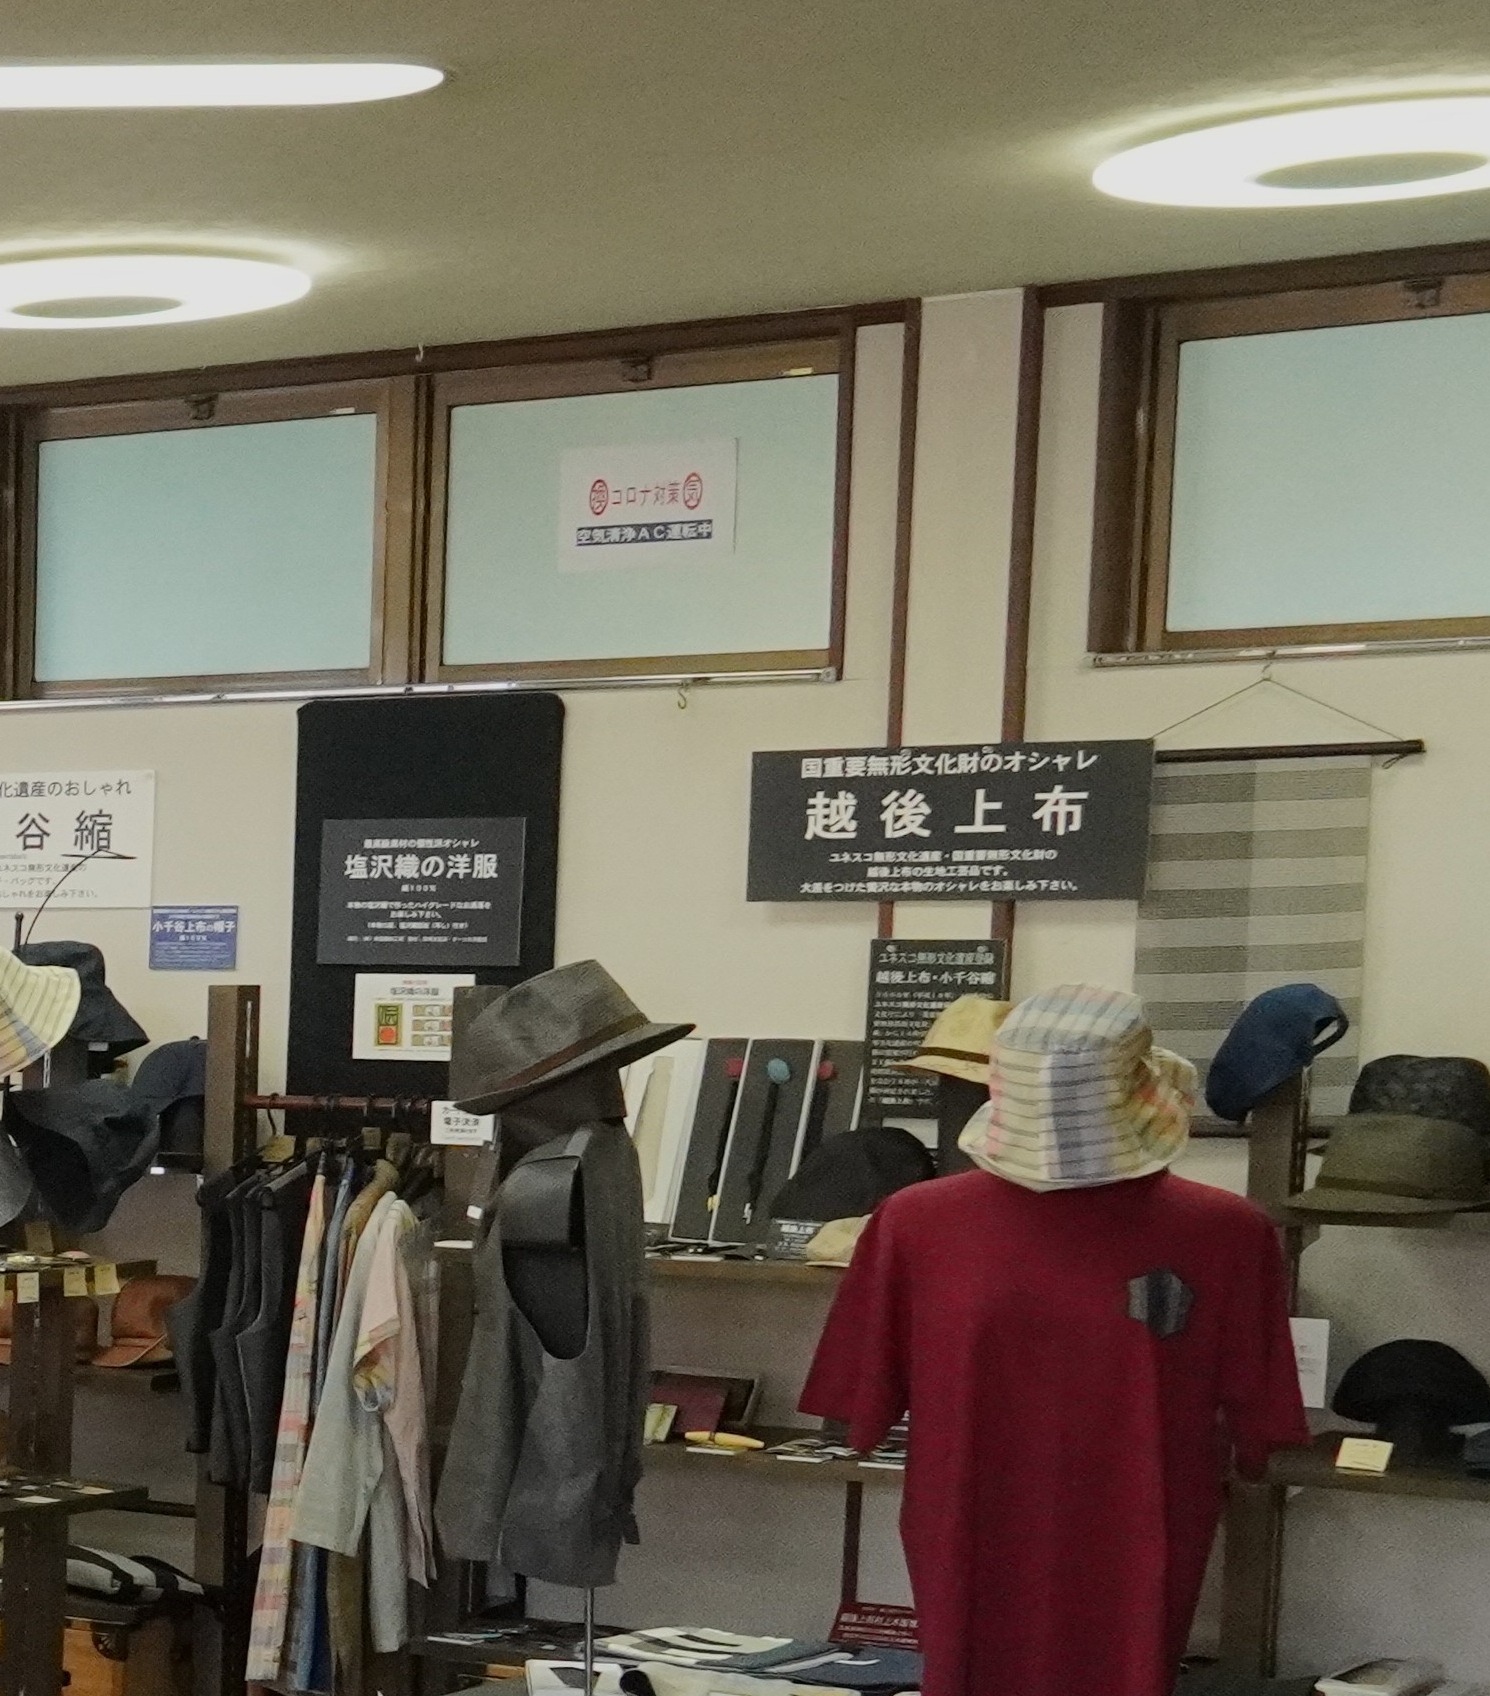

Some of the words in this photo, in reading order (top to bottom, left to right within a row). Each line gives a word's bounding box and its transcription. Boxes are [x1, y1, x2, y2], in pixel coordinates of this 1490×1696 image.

[800, 750, 1099, 779] 国重要無形文化財のオシャレ
[803, 785, 1090, 840] 越後上布
[344, 853, 499, 880] 塩沢織の洋服
